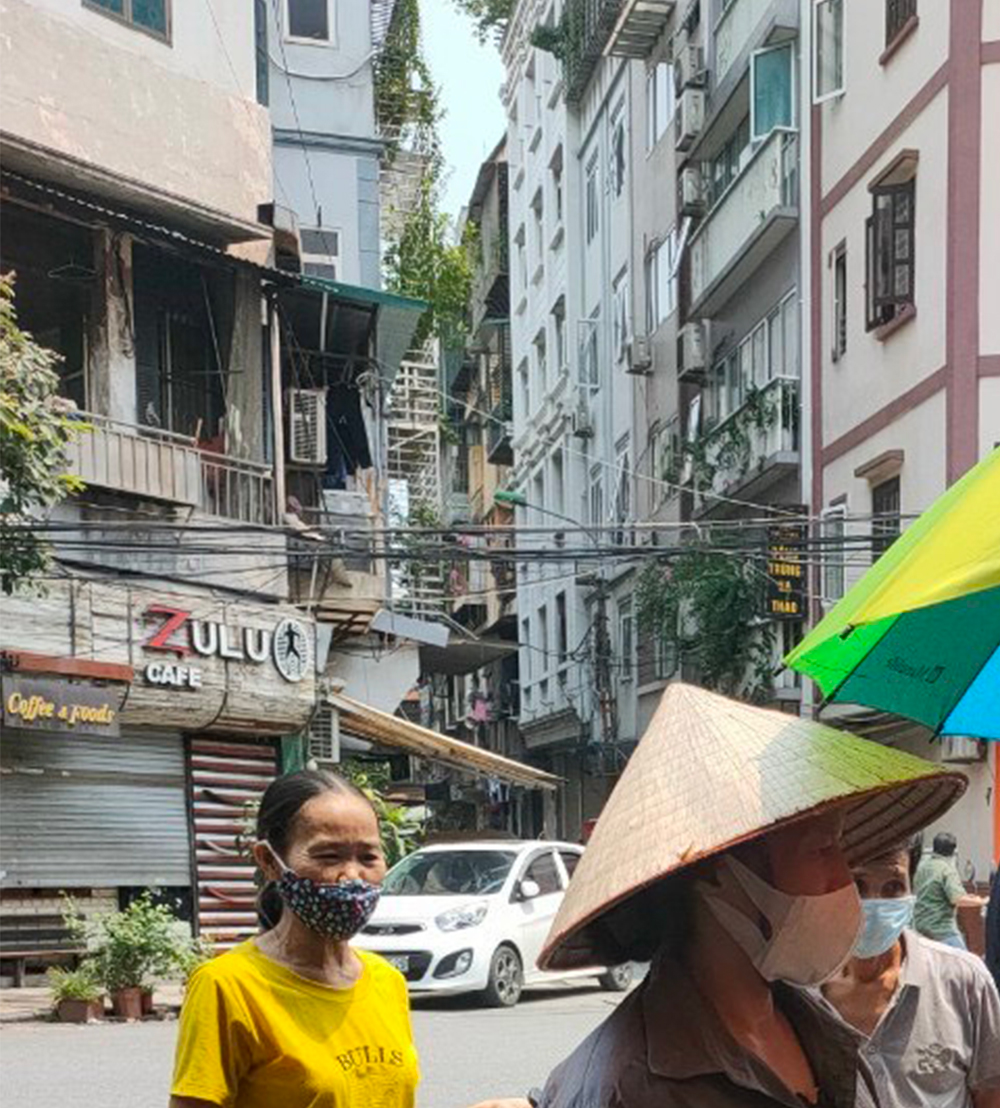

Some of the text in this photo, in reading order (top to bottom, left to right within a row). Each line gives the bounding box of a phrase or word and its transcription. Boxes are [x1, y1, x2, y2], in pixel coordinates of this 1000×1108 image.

[141, 602, 270, 662] ZULU
[8, 692, 55, 721] Coffee
[336, 1045, 404, 1071] BULLS
